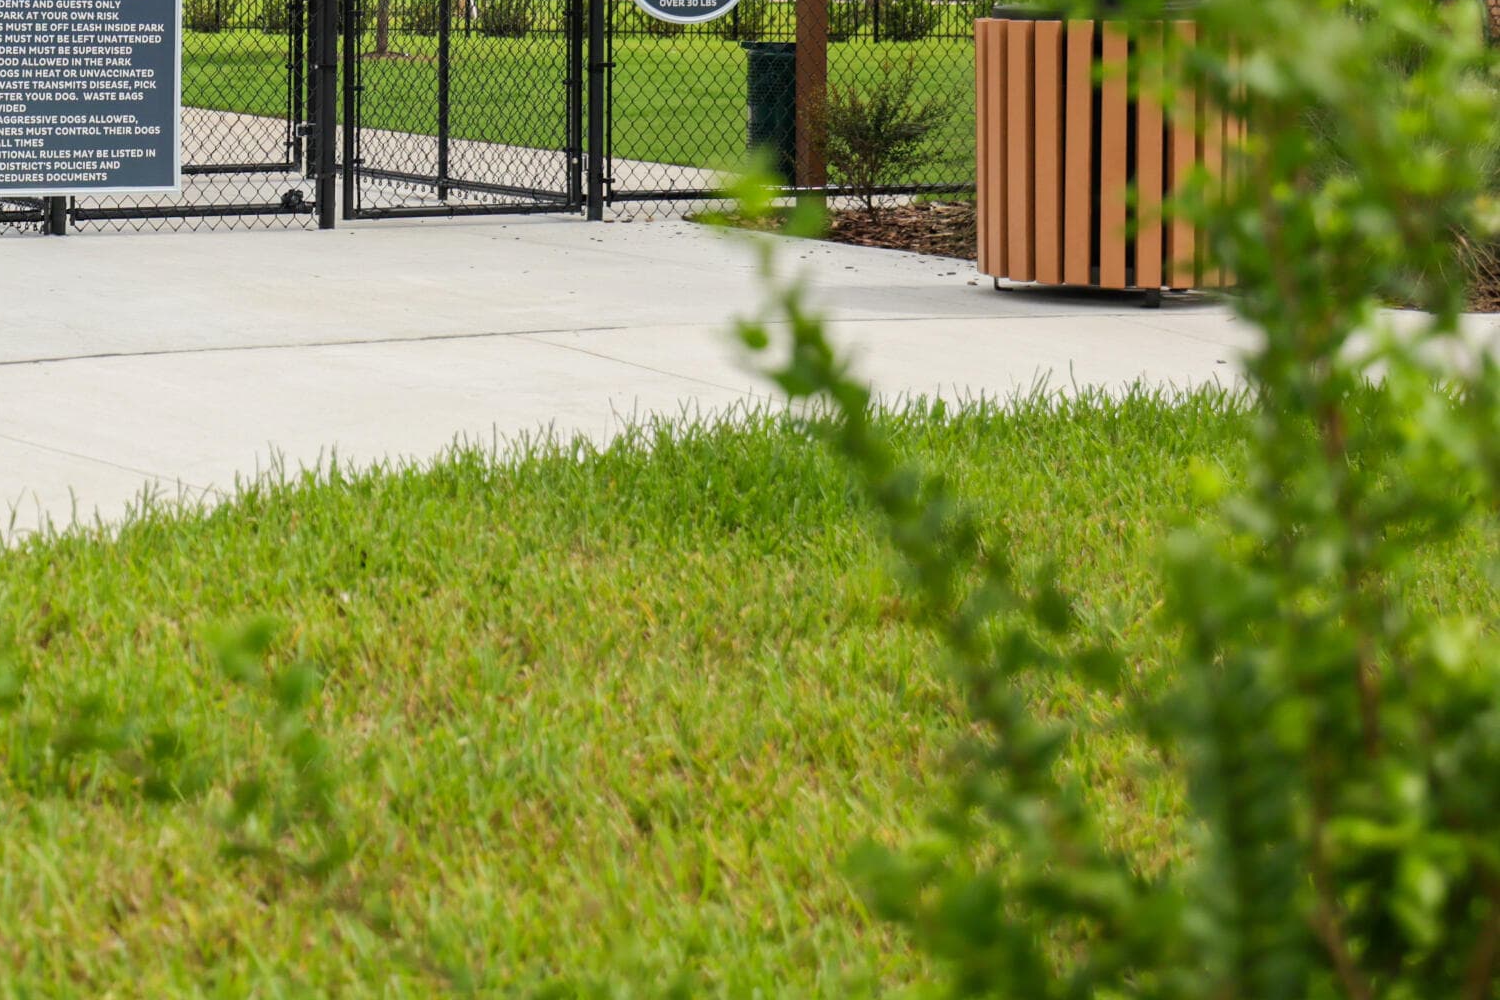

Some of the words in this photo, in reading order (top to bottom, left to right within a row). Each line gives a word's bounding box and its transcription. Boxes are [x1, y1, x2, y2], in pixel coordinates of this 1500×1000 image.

[32, 0, 54, 8] AND
[56, 0, 93, 8] GUESTS
[95, 0, 121, 8] ONLY
[26, 12, 39, 20] AT
[41, 12, 68, 20] YOUR
[70, 12, 94, 20] OWN
[97, 12, 119, 20] RISK
[57, 35, 69, 43] BE
[98, 35, 161, 43] UNATTENDED
[21, 58, 69, 66] ALLOWED
[84, 58, 103, 66] THE
[106, 58, 131, 66] PARK
[35, 69, 61, 77] HEAT
[63, 69, 77, 77] OR
[80, 69, 154, 77] UNVACCINATED
[32, 81, 87, 89] TRANSMITS
[90, 81, 131, 90] DISEASE,
[25, 92, 52, 101] YOUR
[55, 92, 78, 100] DOG.
[83, 92, 116, 100] WASTE
[119, 92, 143, 100] BAGS
[60, 115, 86, 124] DOGS
[89, 115, 138, 124] ALLOWED,
[26, 127, 53, 135] MUST
[55, 127, 101, 135] CONTROL
[103, 126, 132, 134] THEIR
[134, 126, 160, 134] DOGS
[14, 138, 44, 147] TIMES
[40, 150, 71, 158] RULES
[73, 150, 94, 158] MAY
[96, 150, 108, 158] BE
[111, 149, 143, 158] LISTED
[0, 162, 52, 170] DISTRICT'S
[54, 161, 97, 170] POLICIES
[100, 161, 120, 169] AND
[46, 172, 107, 182] DOCUMENTS
